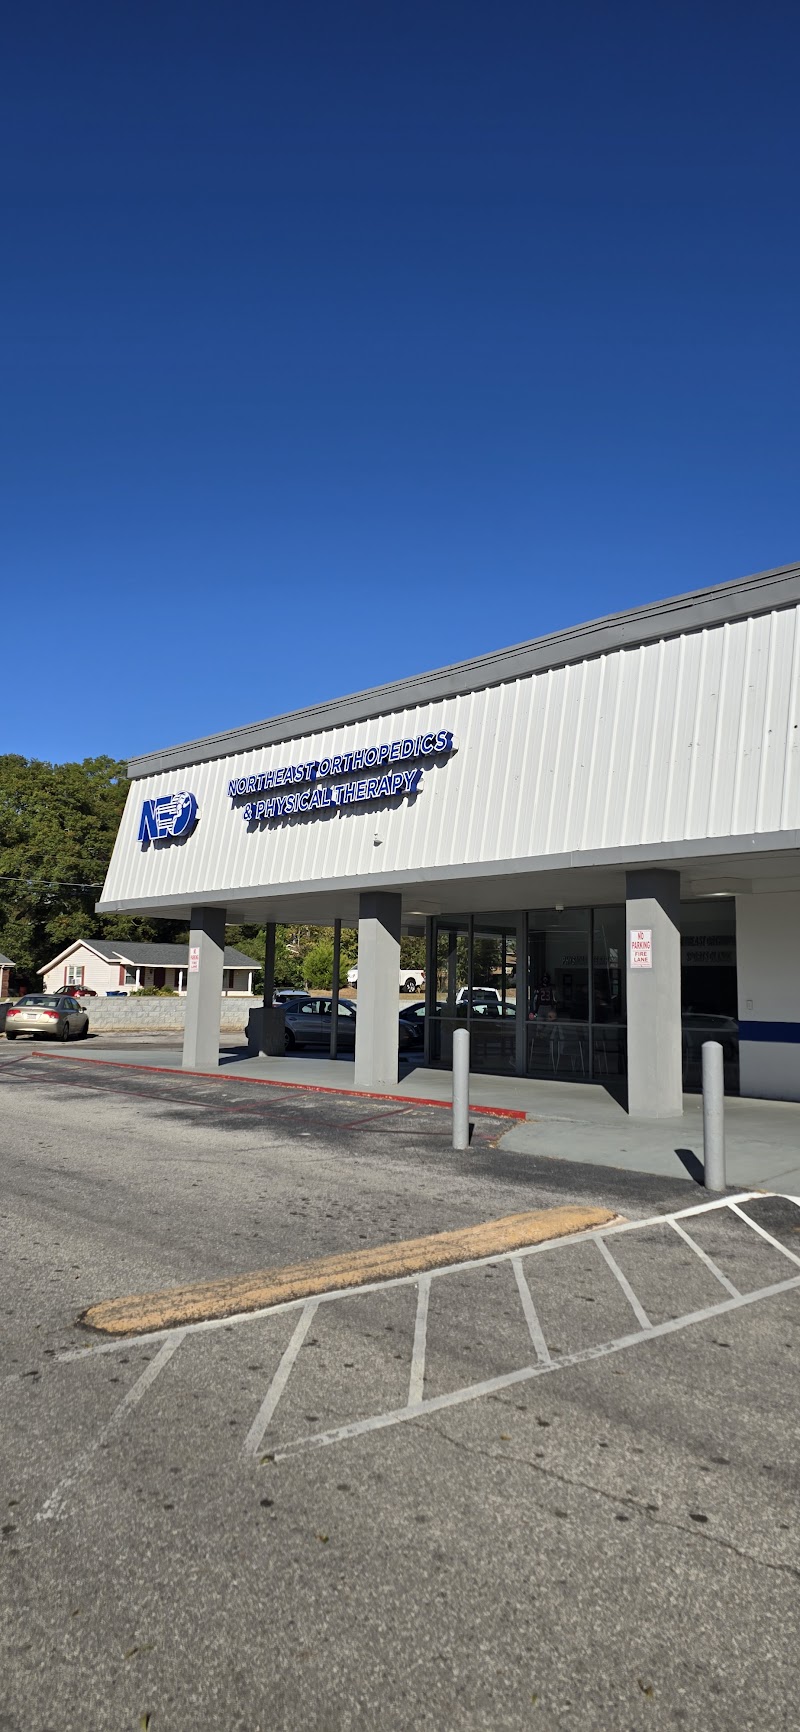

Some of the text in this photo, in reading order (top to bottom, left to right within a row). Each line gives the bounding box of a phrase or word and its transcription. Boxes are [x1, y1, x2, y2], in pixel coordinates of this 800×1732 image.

[227, 729, 451, 797] NORTHEAST ORTHOPEDICS
[243, 769, 419, 821] & PHYSICAL THERAPY
[637, 932, 645, 940] NO
[631, 941, 650, 949] PARKING
[540, 990, 551, 1001] 23
